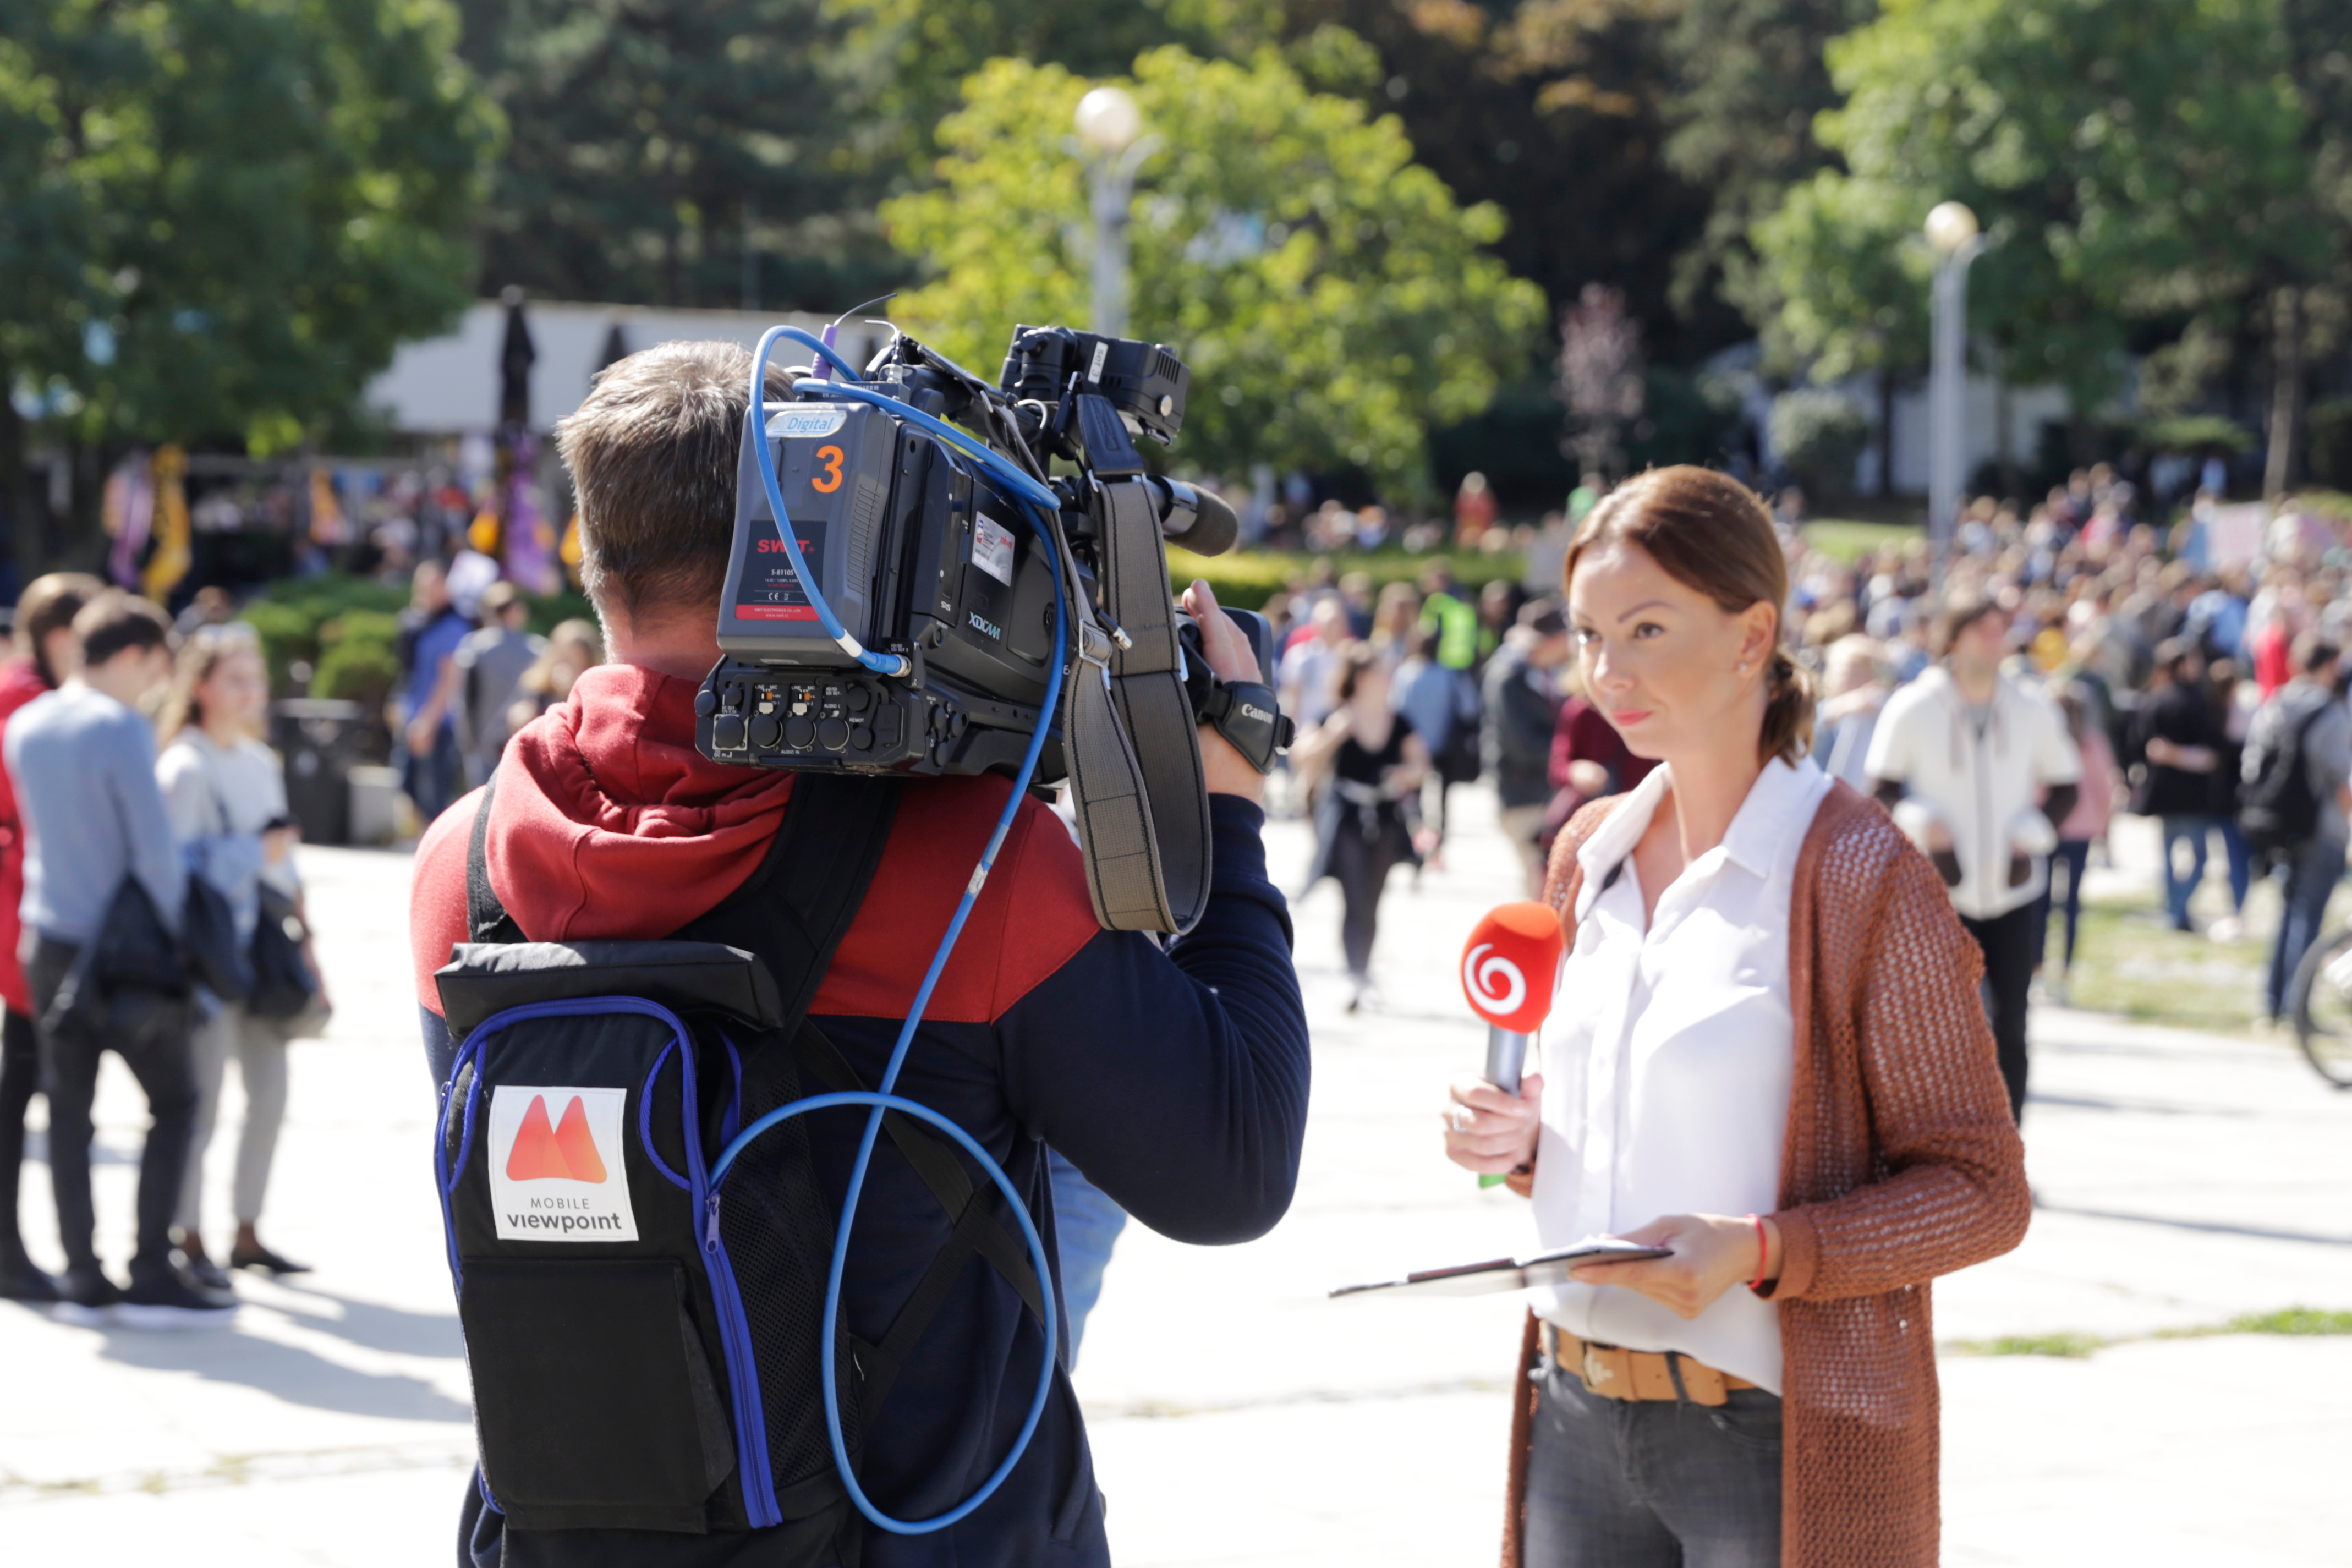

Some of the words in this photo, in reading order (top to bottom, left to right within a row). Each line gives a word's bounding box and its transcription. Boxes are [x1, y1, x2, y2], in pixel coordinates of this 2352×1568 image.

[812, 445, 845, 493] 3
[757, 539, 810, 553] SWT
[968, 611, 1000, 640] XDCAM
[1241, 703, 1274, 725] Canon
[531, 1198, 590, 1209] MOBILE
[507, 1213, 622, 1233] viewpoint
